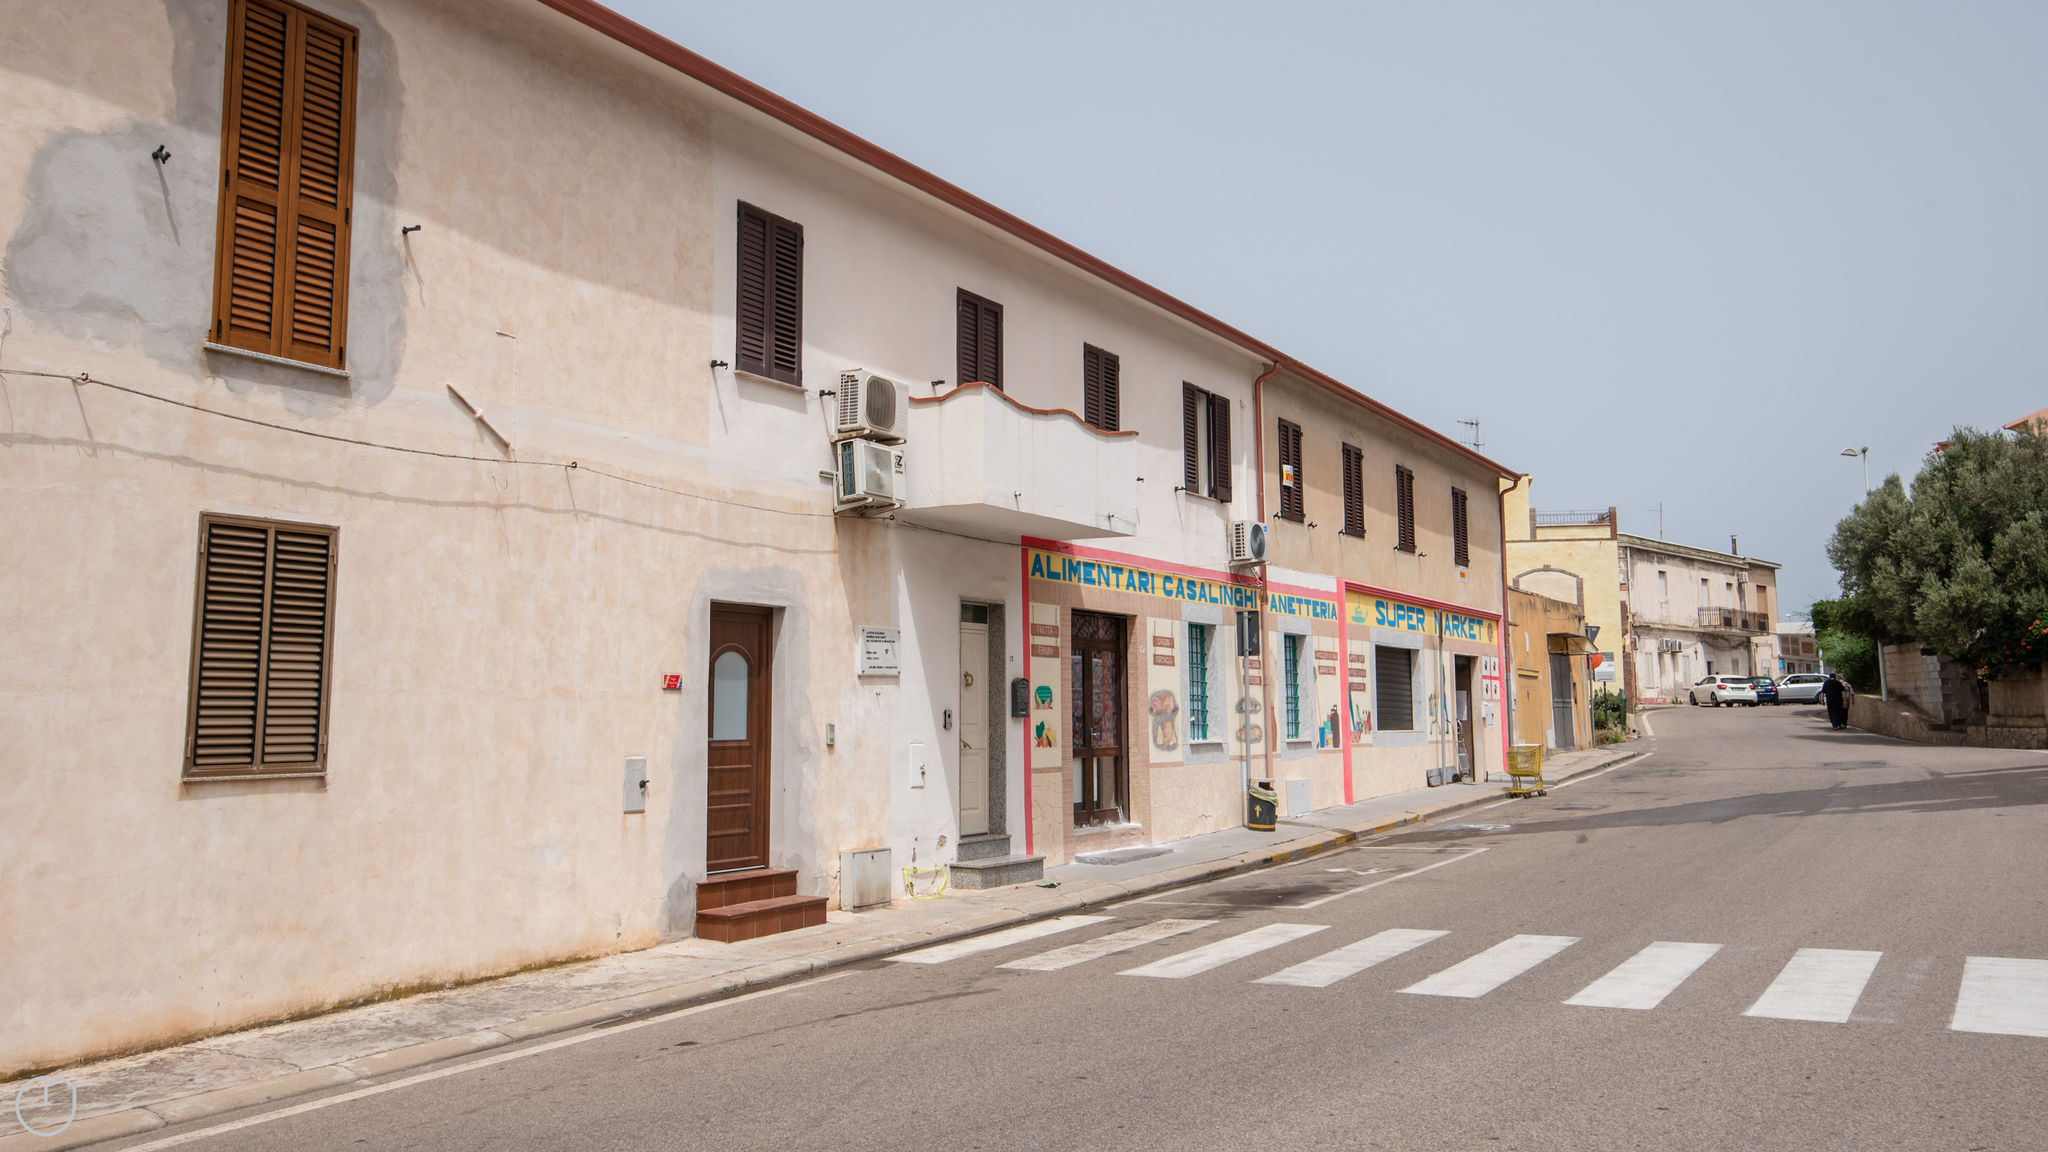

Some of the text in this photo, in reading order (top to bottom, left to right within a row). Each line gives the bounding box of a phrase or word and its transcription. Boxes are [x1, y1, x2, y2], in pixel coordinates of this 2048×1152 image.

[1031, 553, 1337, 620] ALIMENTARI CASALINGHI ANETTERIA
[1375, 600, 1426, 633] SUPER
